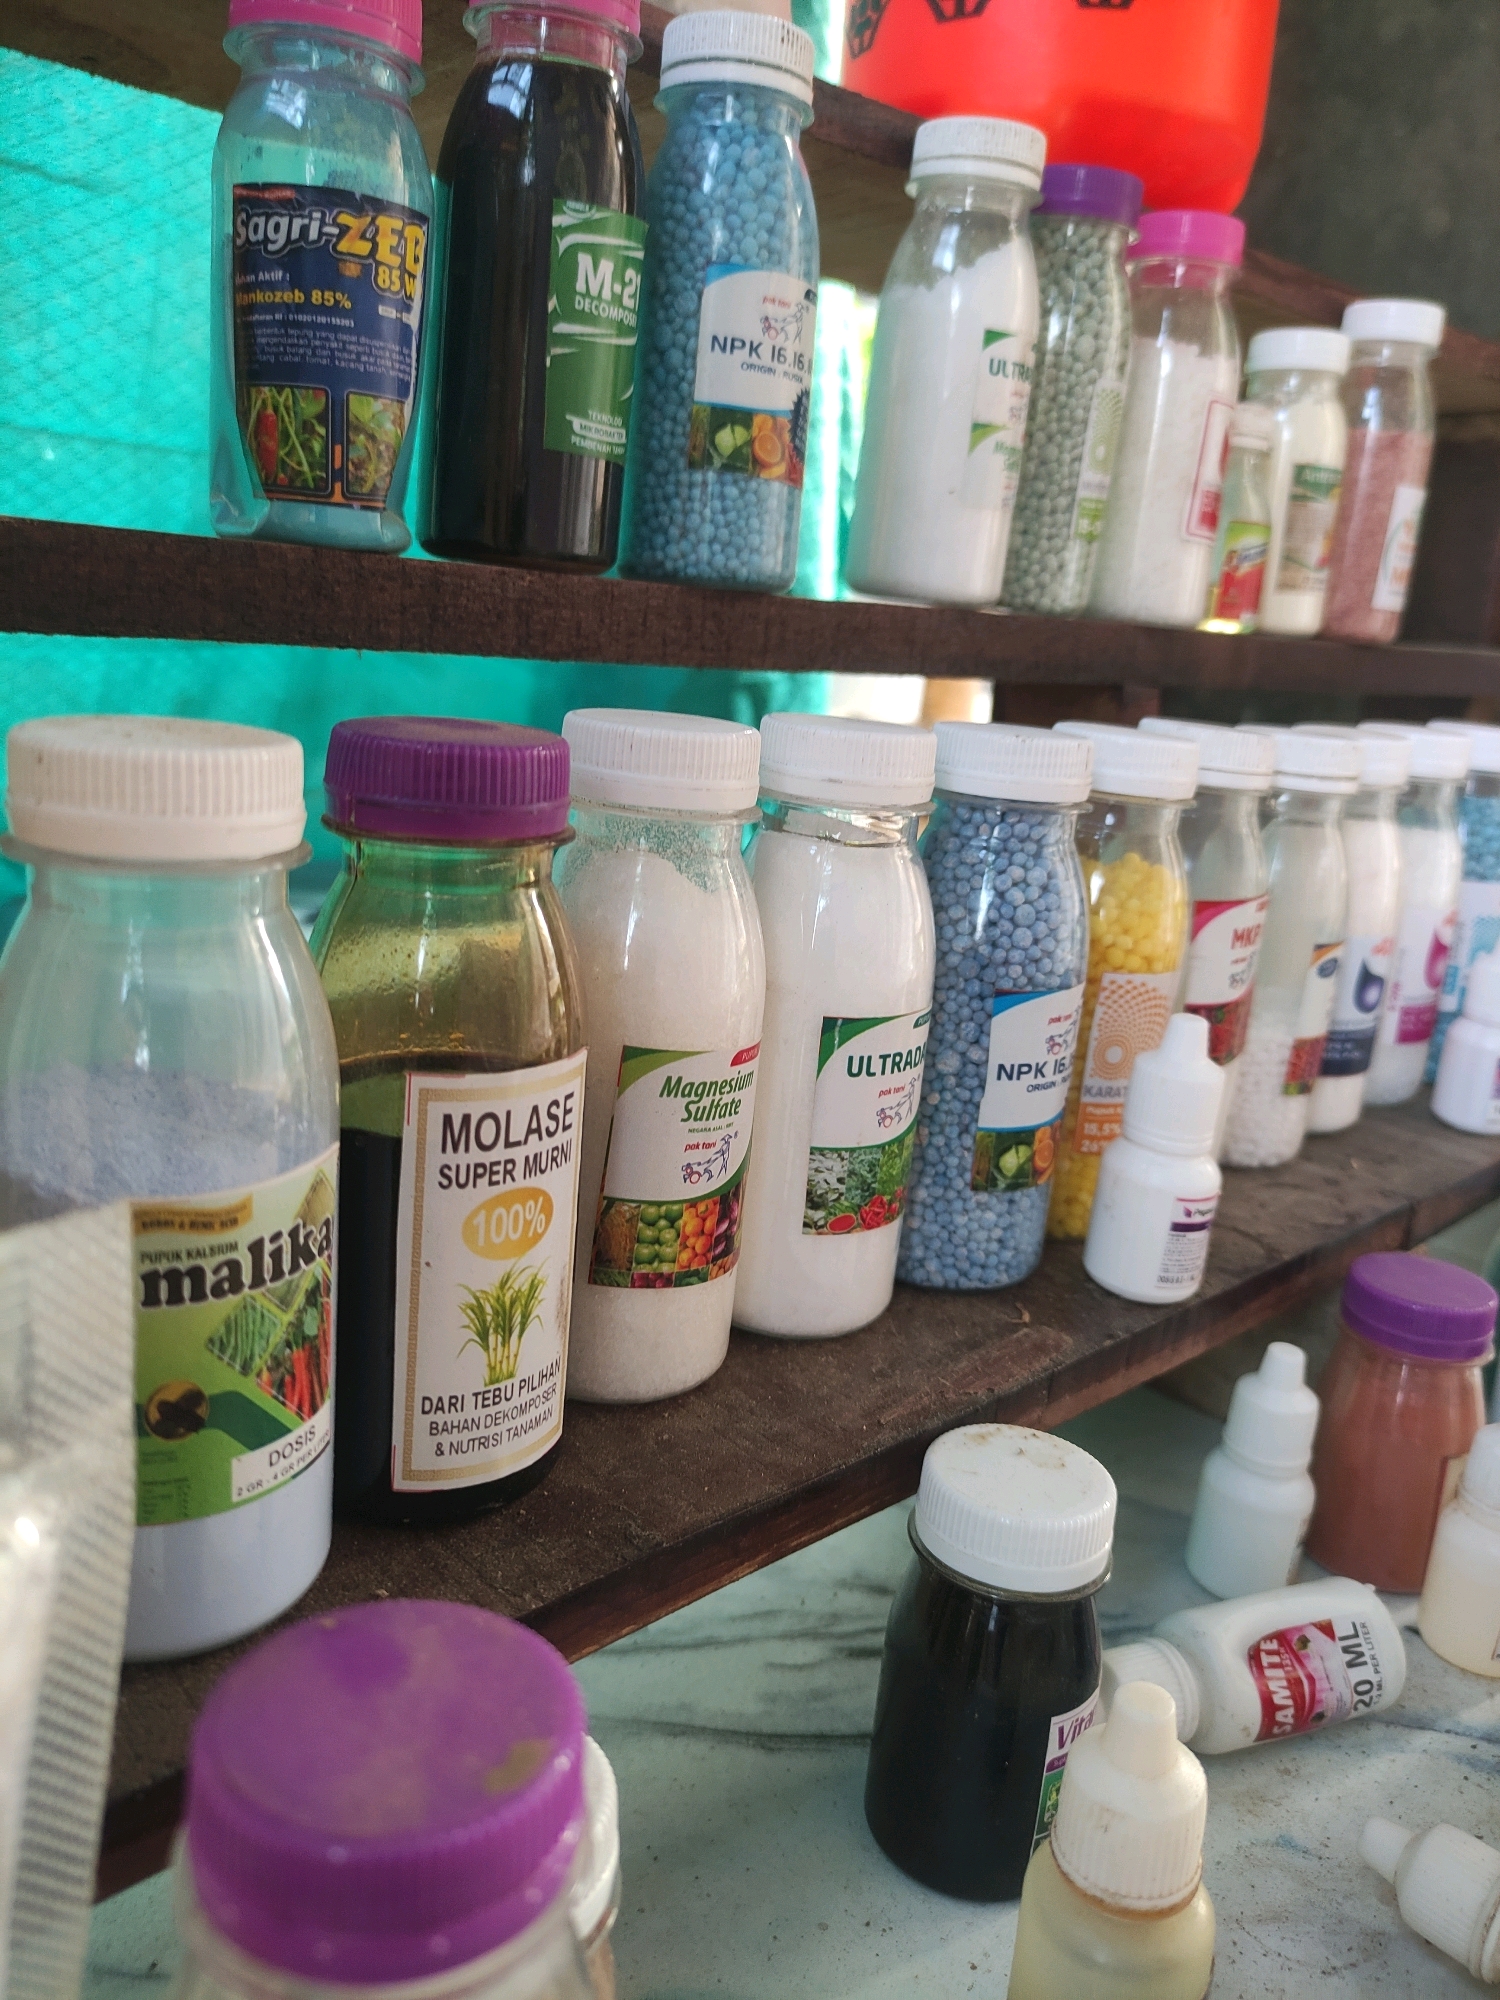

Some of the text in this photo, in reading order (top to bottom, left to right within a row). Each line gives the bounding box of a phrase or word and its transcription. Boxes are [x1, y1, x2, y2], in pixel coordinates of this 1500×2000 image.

[258, 270, 283, 282] Aktif
[377, 265, 400, 293] 85
[311, 289, 352, 310] 85%
[710, 334, 763, 360] NPK
[740, 361, 776, 378] ORIGIN
[659, 1069, 755, 1102] Magnesium
[996, 1060, 1048, 1081] NPK
[1026, 1080, 1056, 1094] ORIGIN
[878, 1086, 892, 1099] pak
[441, 1091, 574, 1155] MOLASE
[680, 1096, 742, 1123] Sulfate
[684, 1138, 718, 1154] pak tani
[437, 1138, 572, 1190] SUPER MURNI
[473, 1195, 546, 1247] 100%
[140, 1215, 333, 1309] malika
[421, 1355, 561, 1416] DARI TEBU PILIHAN
[429, 1382, 557, 1437] BAHAN DEKOMPOSER
[268, 1424, 316, 1468] DOSIS
[435, 1404, 553, 1457] & NUTRISI TANAMAN
[1337, 1620, 1369, 1670] ML
[1359, 1621, 1375, 1651] LITER
[1369, 1652, 1382, 1675] PER
[1259, 1638, 1296, 1736] SAMITE
[1353, 1678, 1374, 1712] 20
[1058, 1708, 1095, 1751] Vita
